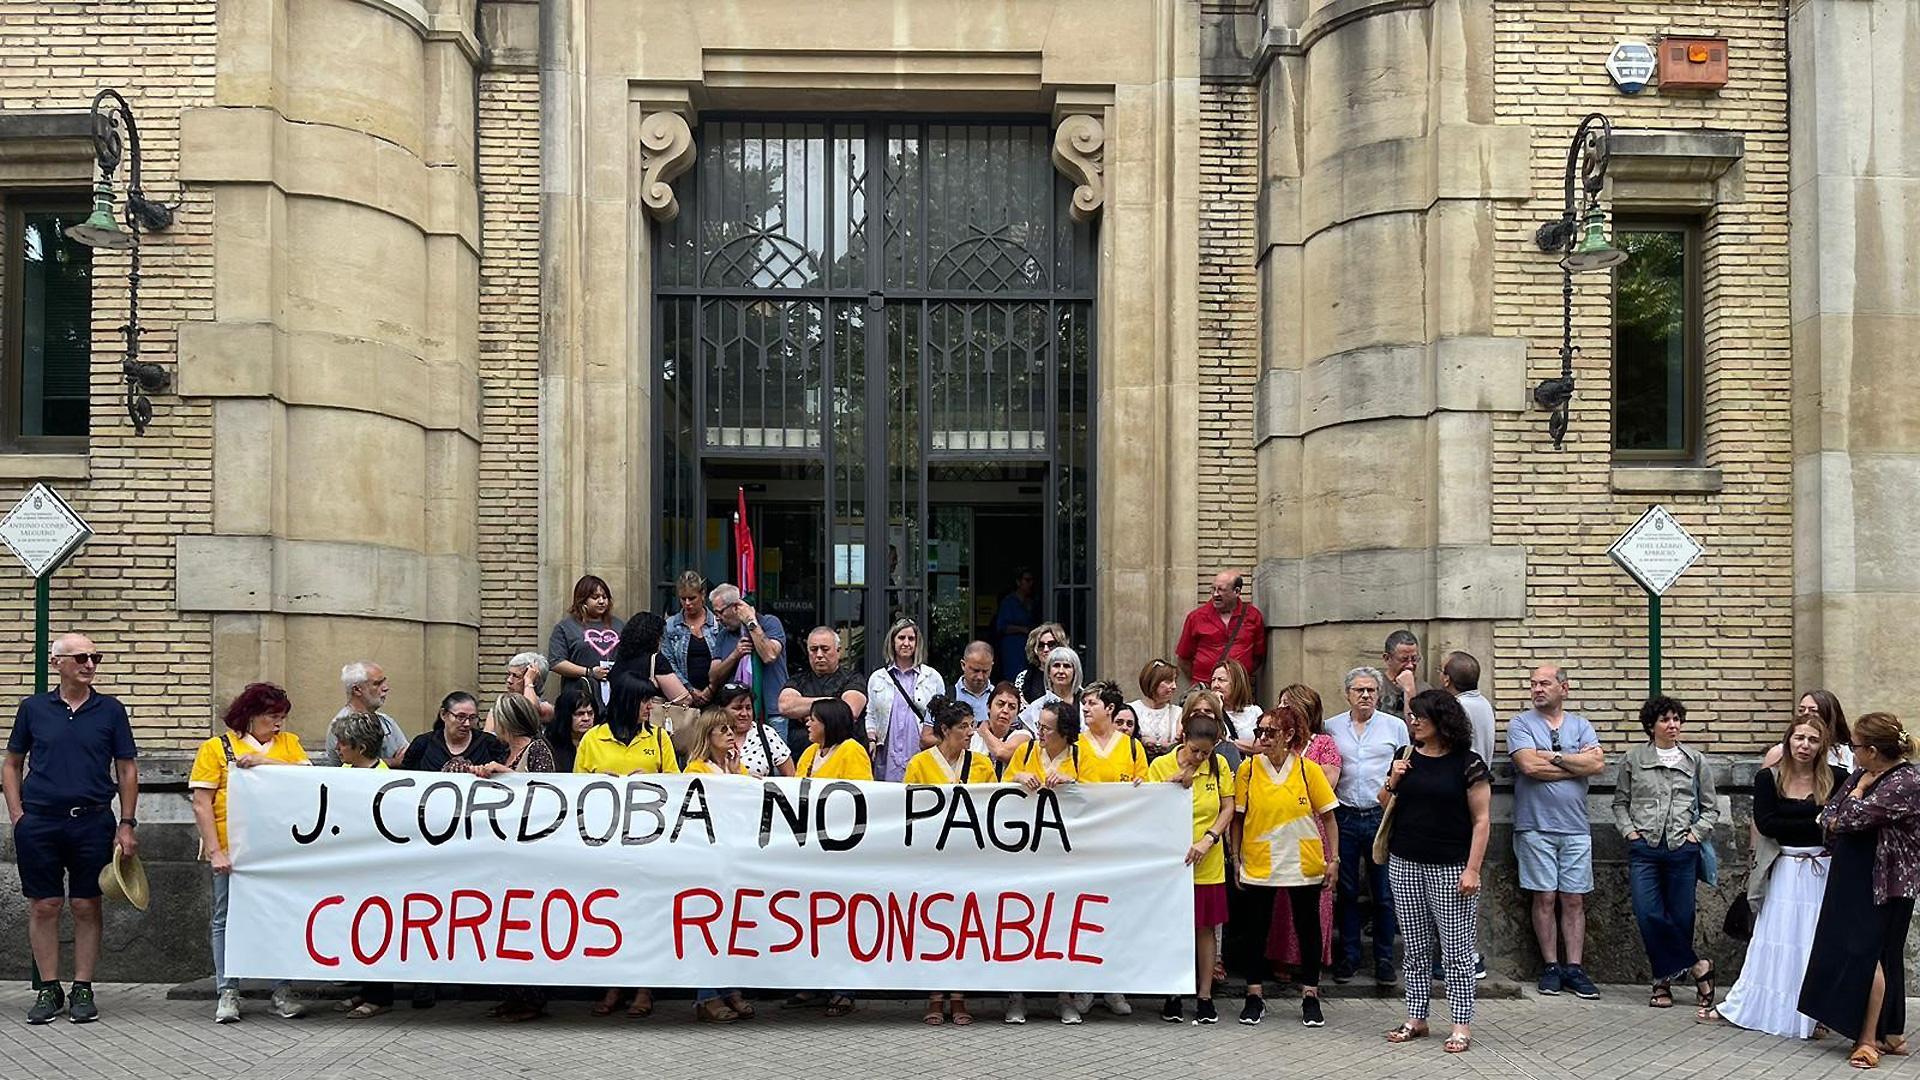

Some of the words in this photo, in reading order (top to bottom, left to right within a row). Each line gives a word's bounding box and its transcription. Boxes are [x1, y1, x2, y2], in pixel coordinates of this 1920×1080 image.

[773, 601, 814, 610] ENTRADA
[291, 783, 340, 845] J.
[372, 777, 716, 847] CORDOBA
[758, 776, 869, 852] NO
[904, 784, 1073, 853] PAGA
[305, 887, 624, 967] CORREOS
[673, 887, 1110, 966] RESPONSABLE
